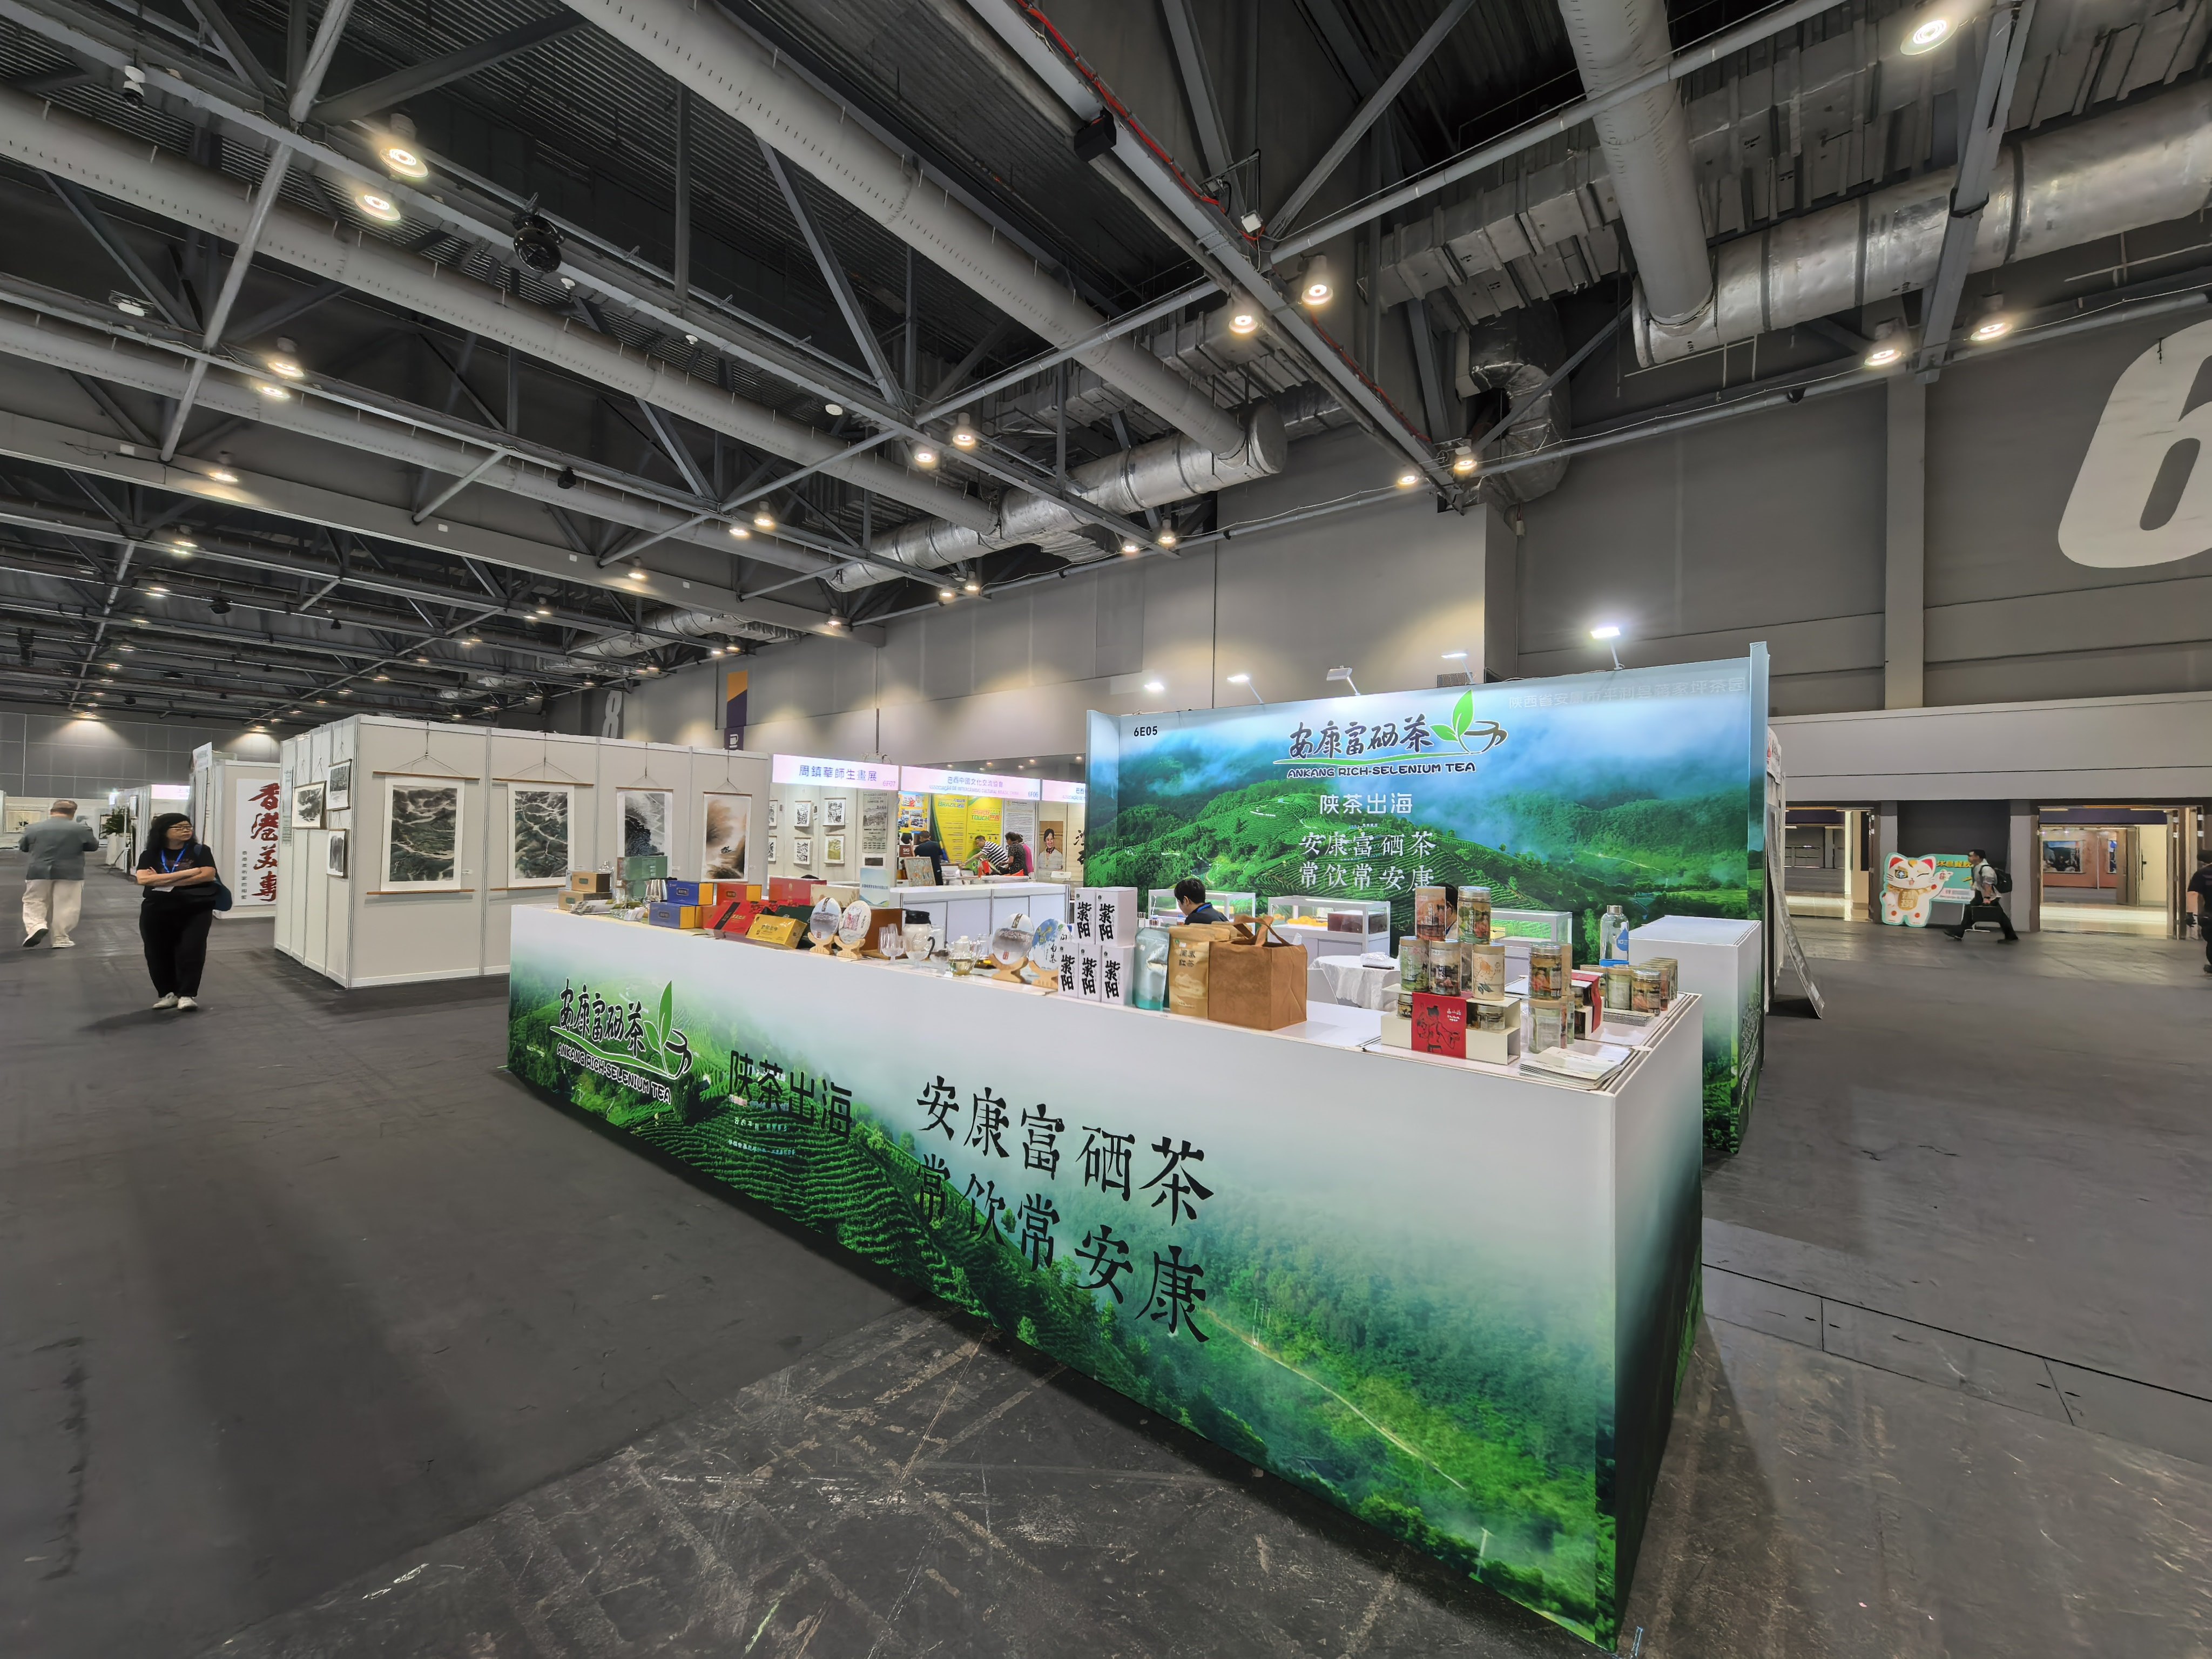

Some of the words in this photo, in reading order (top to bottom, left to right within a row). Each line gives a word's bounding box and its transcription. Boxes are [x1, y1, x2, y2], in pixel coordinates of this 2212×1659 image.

[2058, 318, 2212, 568] 6
[1133, 725, 1158, 737] 6E05
[1289, 713, 1434, 758] 安康富硒茶
[799, 764, 877, 782] 周鎮華師生畫展
[1287, 768, 1335, 779] ANKANG
[1338, 764, 1441, 776] RICH-SELENIUM
[1445, 762, 1476, 773] TEA
[1320, 792, 1413, 814] 陕茶出海
[1298, 830, 1437, 859] 安康富硒茶
[1299, 861, 1434, 894] 常饮常安康
[1077, 901, 1092, 939] 紫阳
[1098, 903, 1115, 941] 紫阳
[1061, 954, 1075, 992] 紫阳
[1082, 957, 1097, 995] 紫阳
[1104, 960, 1121, 999] 紫阳
[559, 978, 646, 1057] 安康富硒茶
[557, 1042, 585, 1066] ANKANG
[586, 1054, 650, 1094] RICH-SELENIUM
[651, 1081, 671, 1105] TEA
[729, 1050, 852, 1138] 陕茶出海
[917, 1075, 1214, 1226] 安康富硒茶
[917, 1154, 1210, 1343] 常饮常安康
